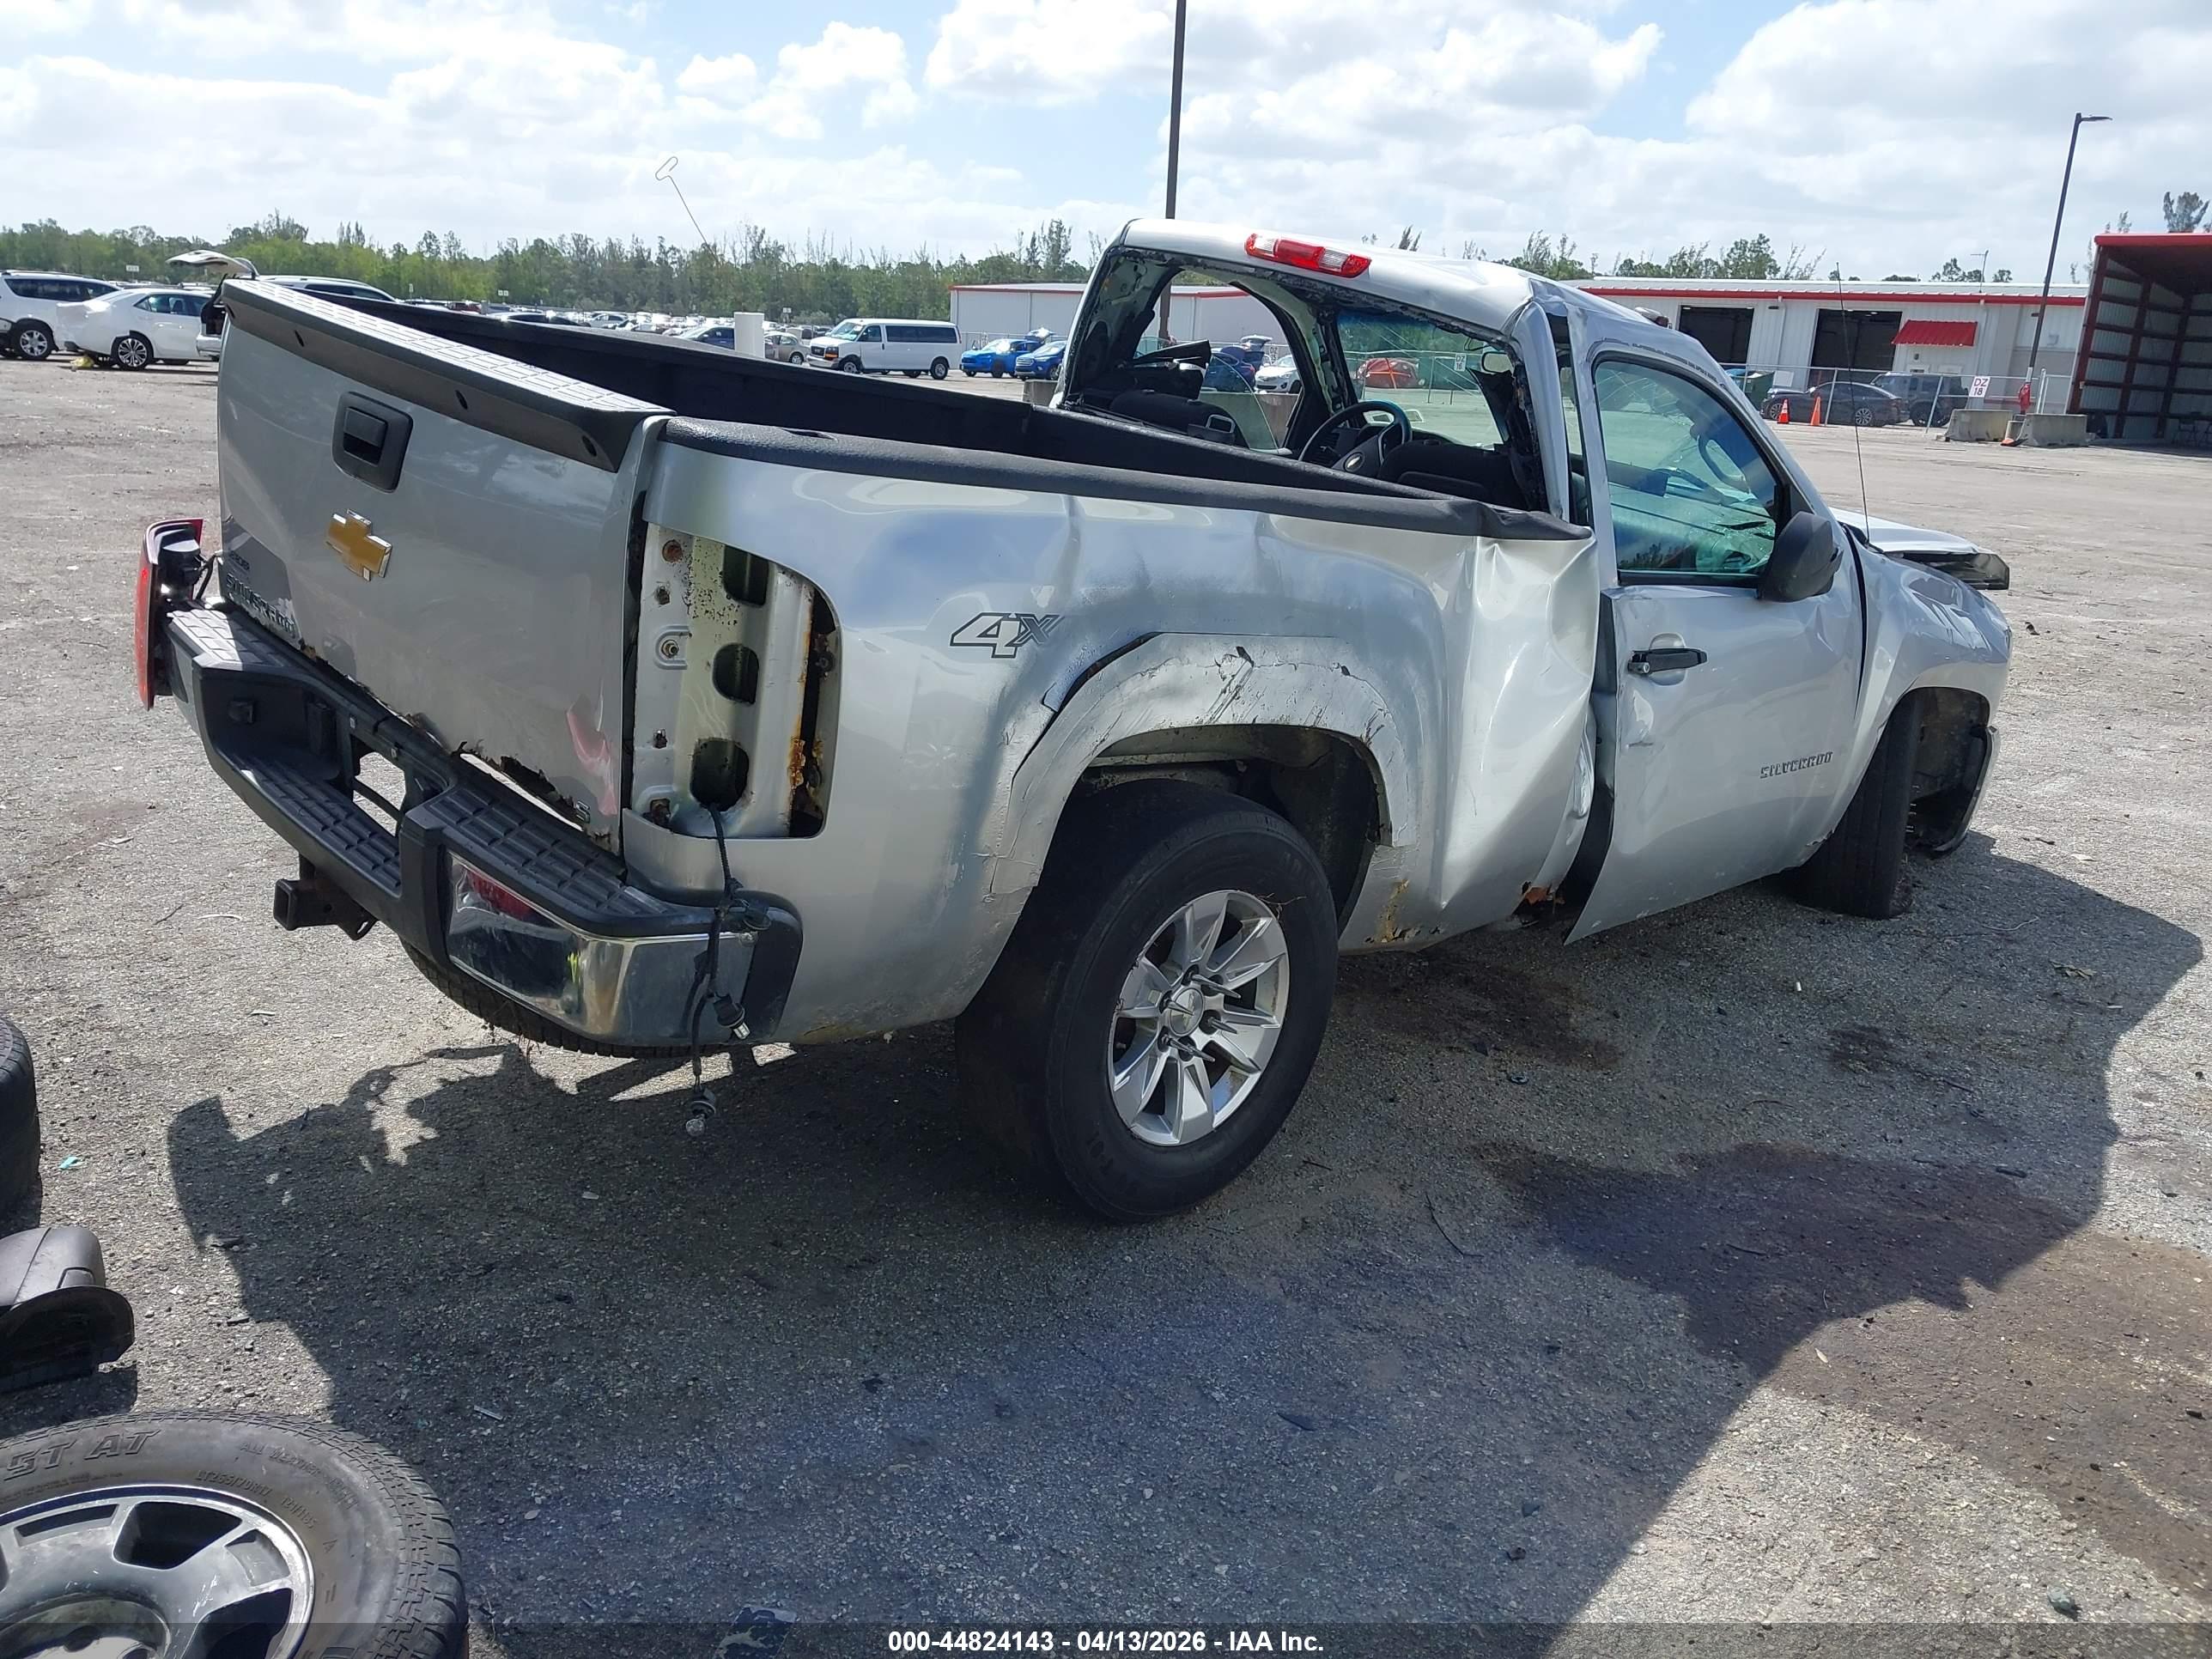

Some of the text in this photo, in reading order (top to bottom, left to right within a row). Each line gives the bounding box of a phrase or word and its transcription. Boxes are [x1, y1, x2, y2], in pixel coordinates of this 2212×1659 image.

[1974, 378, 1988, 386] DZ
[1974, 387, 1984, 396] 18
[1759, 751, 1833, 779] SILVERADO
[84, 1429, 161, 1461] AT
